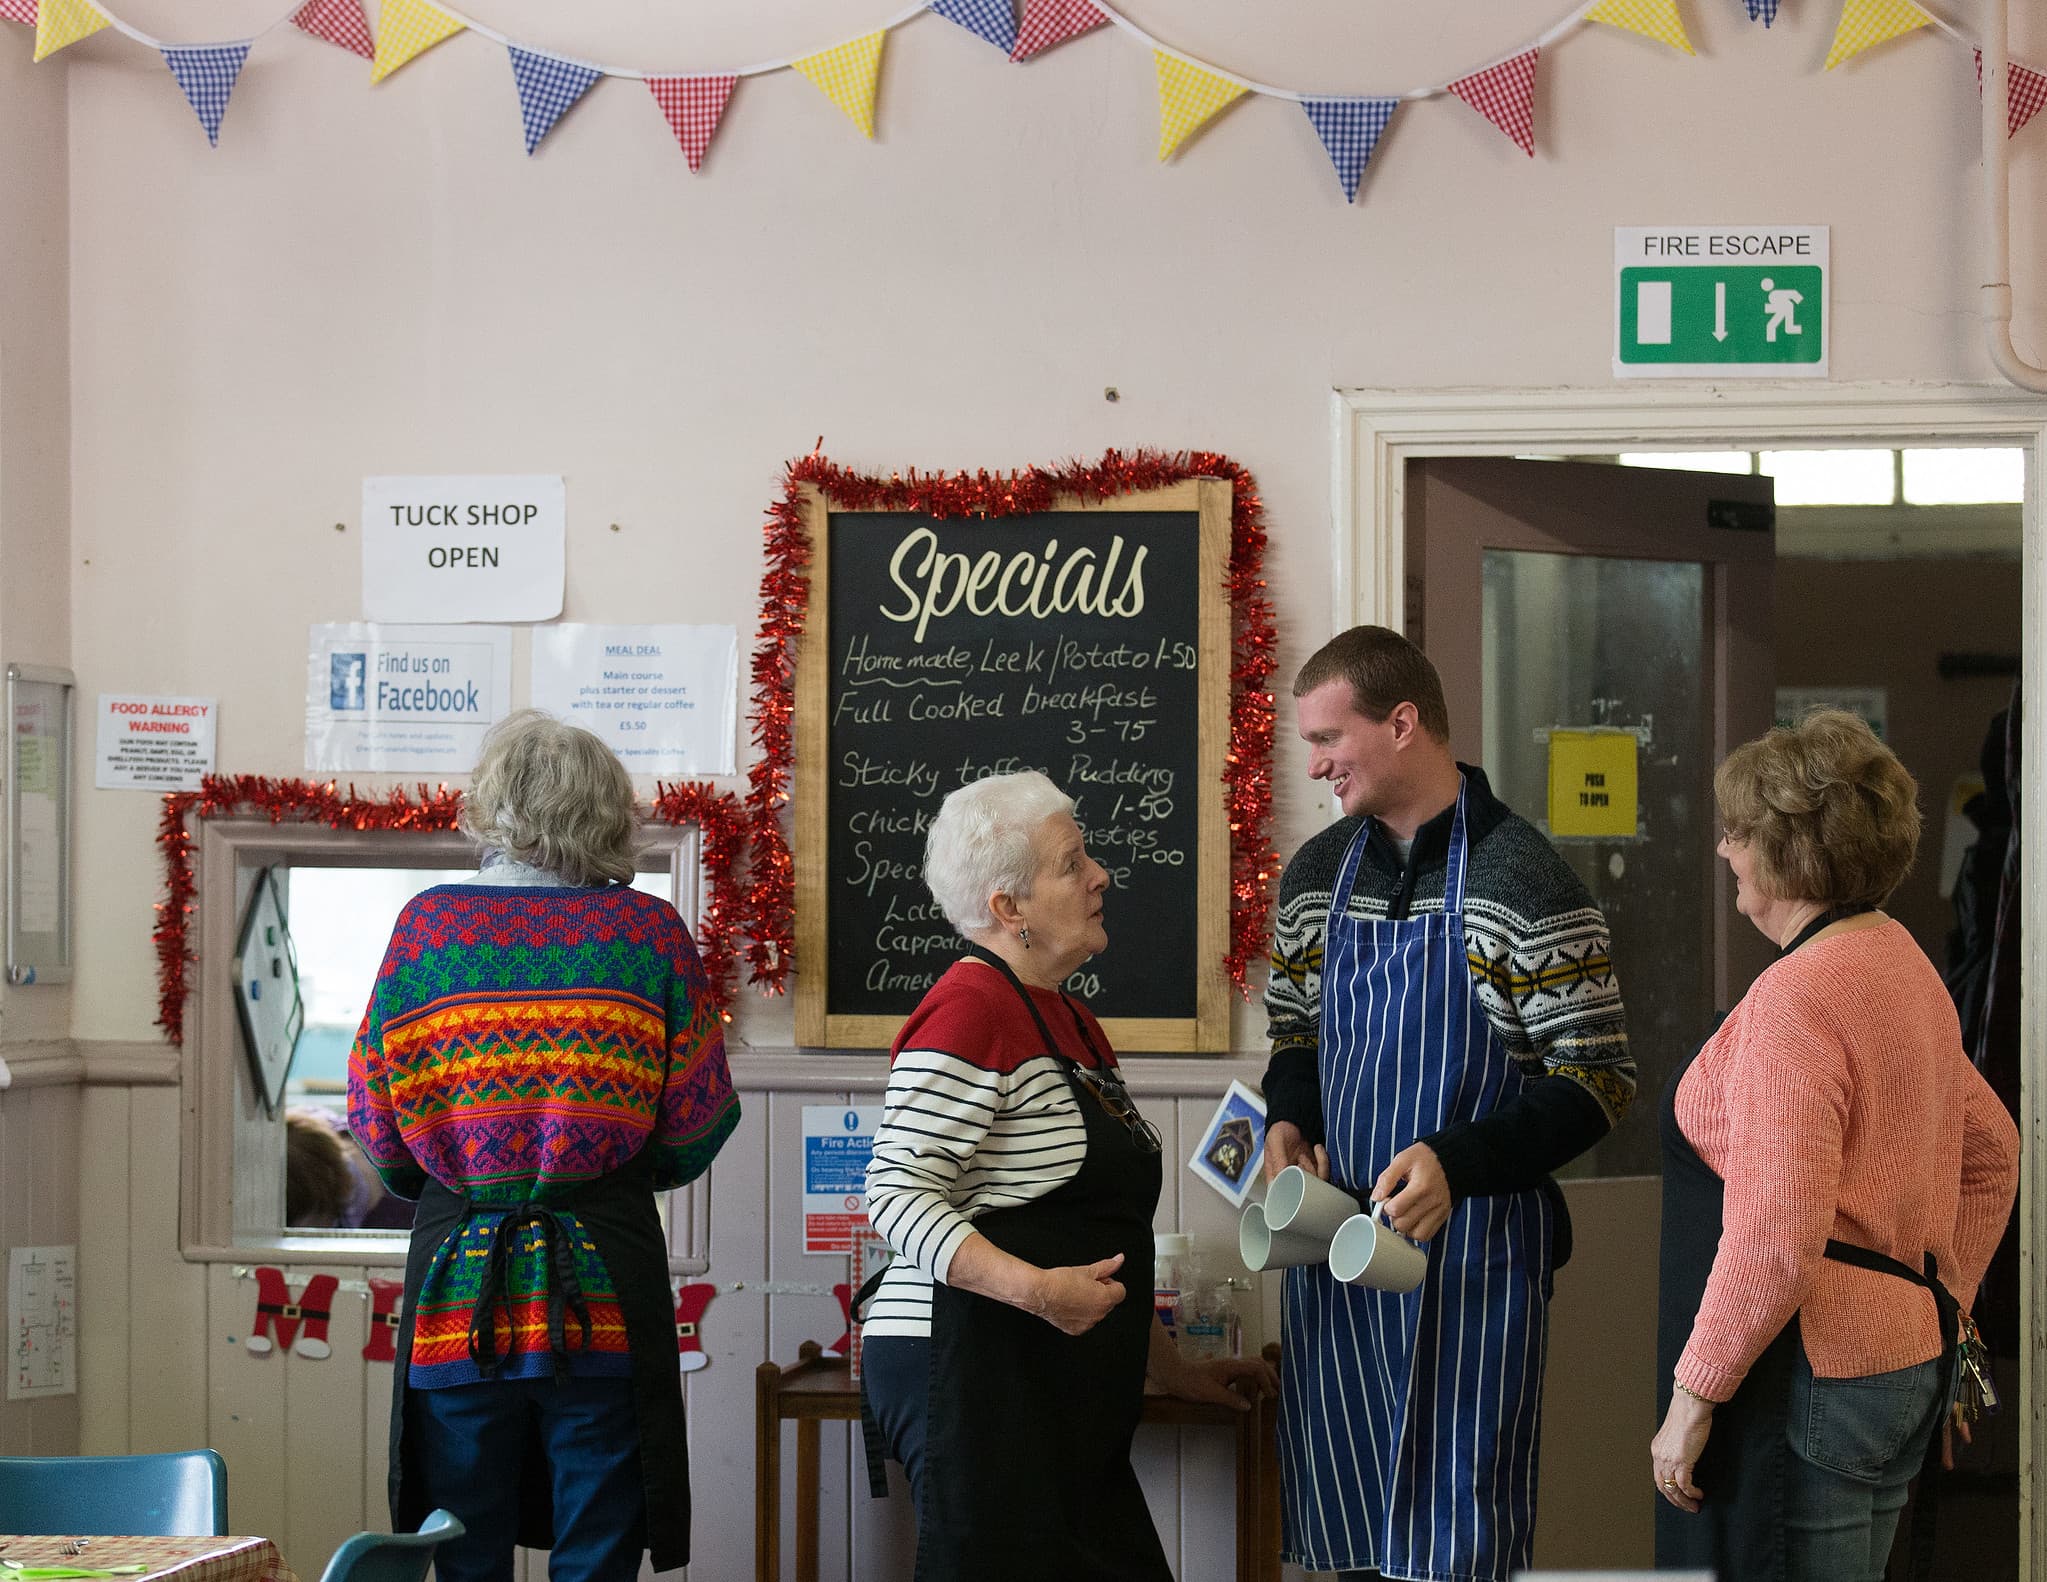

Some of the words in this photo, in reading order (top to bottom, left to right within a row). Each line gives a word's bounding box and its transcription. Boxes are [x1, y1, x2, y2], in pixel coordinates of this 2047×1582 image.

[1644, 236, 1700, 256] FIRE
[1708, 235, 1811, 256] ESCAPE
[390, 504, 459, 527] TUCK
[466, 504, 538, 526] SHOP
[428, 546, 499, 568] OPEN
[879, 527, 1149, 643] Specials
[605, 645, 633, 656] MEAL
[636, 645, 662, 656] DEAL
[377, 651, 409, 673] Find
[412, 657, 429, 673] us
[432, 657, 450, 673] on
[603, 671, 629, 680] Main
[630, 672, 664, 680] course
[377, 679, 479, 712] Facebook
[579, 685, 600, 695] plus
[602, 686, 636, 695] starter
[638, 687, 649, 695] or
[650, 686, 687, 695] dessert
[111, 703, 148, 714] FOOD
[151, 703, 209, 718] ALLERGY
[571, 699, 594, 709] with
[595, 700, 612, 709] tea
[614, 701, 626, 709] or
[627, 700, 662, 711] regular
[663, 699, 695, 709] coffee
[832, 691, 892, 727] Full
[1020, 682, 1158, 722] breakfast
[128, 720, 191, 734] WARNING
[619, 720, 648, 731] £5.50
[839, 751, 940, 797] Sticky
[1067, 753, 1175, 798] Pudding
[1584, 772, 1605, 787] PUSH
[1579, 792, 1589, 806] TO
[1590, 792, 1609, 807] OPEN
[820, 1137, 844, 1149] Fire
